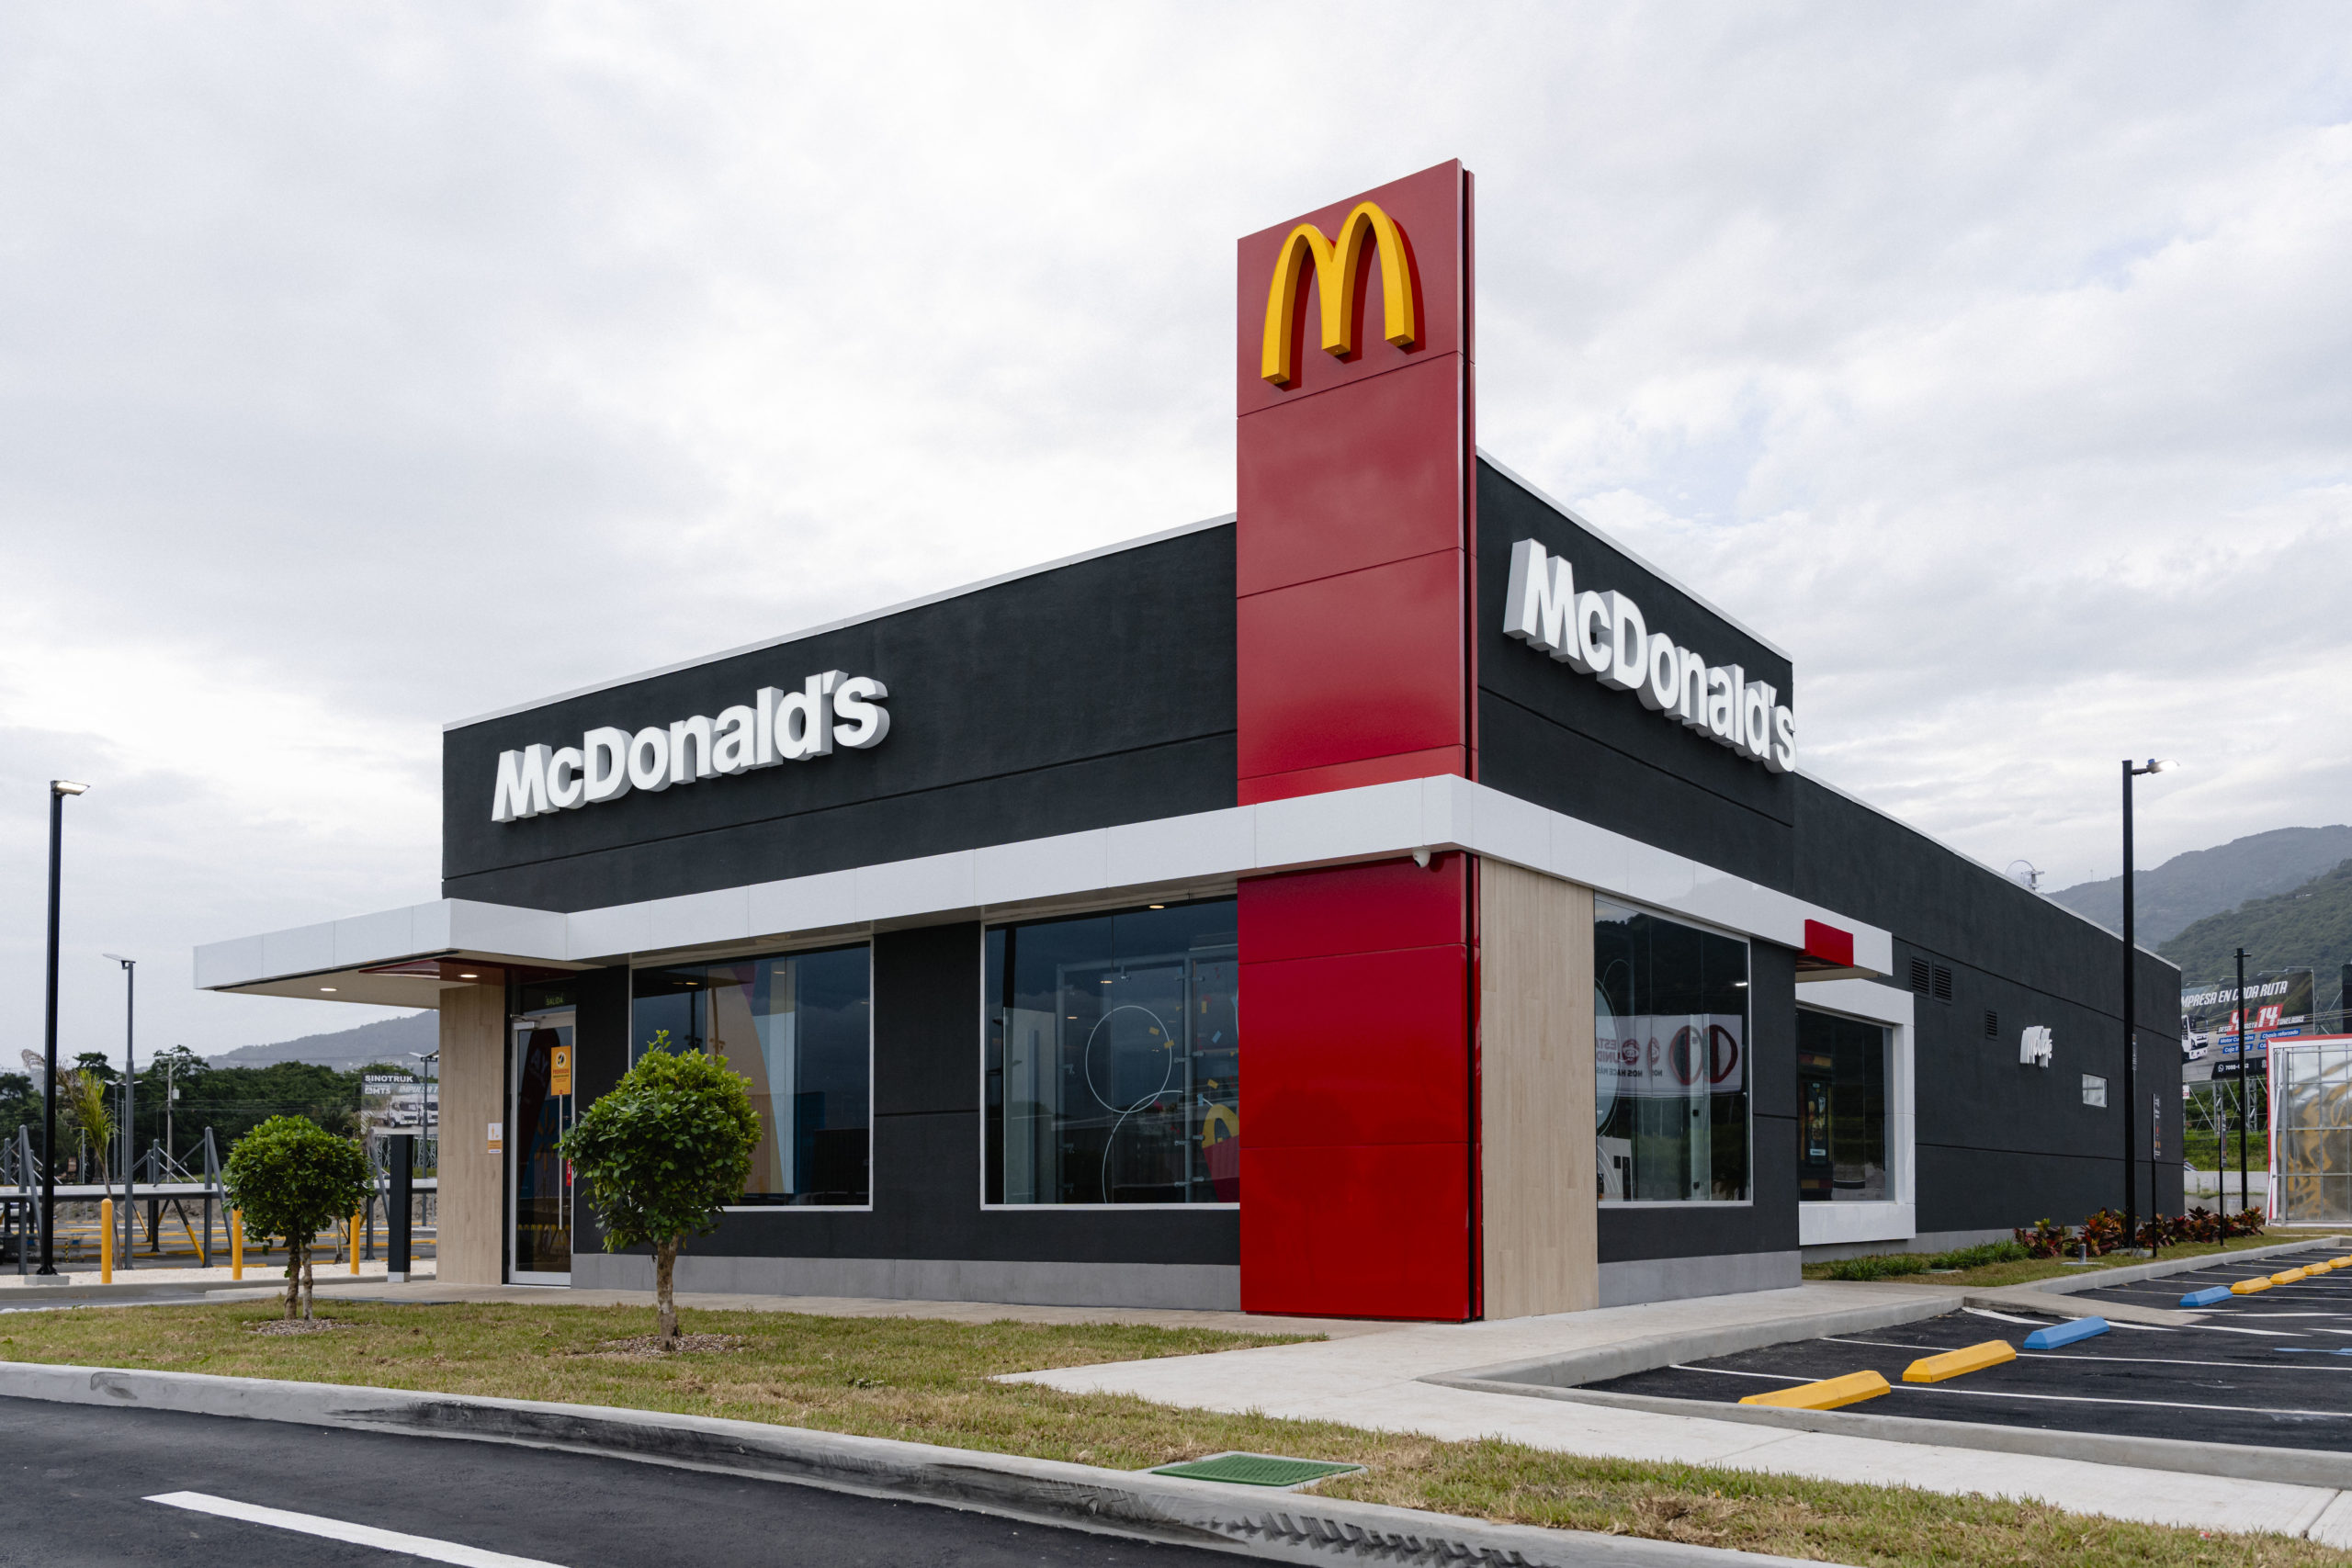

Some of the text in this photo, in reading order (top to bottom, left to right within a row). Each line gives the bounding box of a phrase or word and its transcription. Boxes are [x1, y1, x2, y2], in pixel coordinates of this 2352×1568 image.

[1503, 538, 1797, 773] McDonald's
[492, 670, 890, 822] McDonald's
[2218, 989, 2232, 1003] EN
[2233, 985, 2259, 1001] CDA
[2260, 980, 2288, 997] RUTA
[2258, 1006, 2278, 1028] 14
